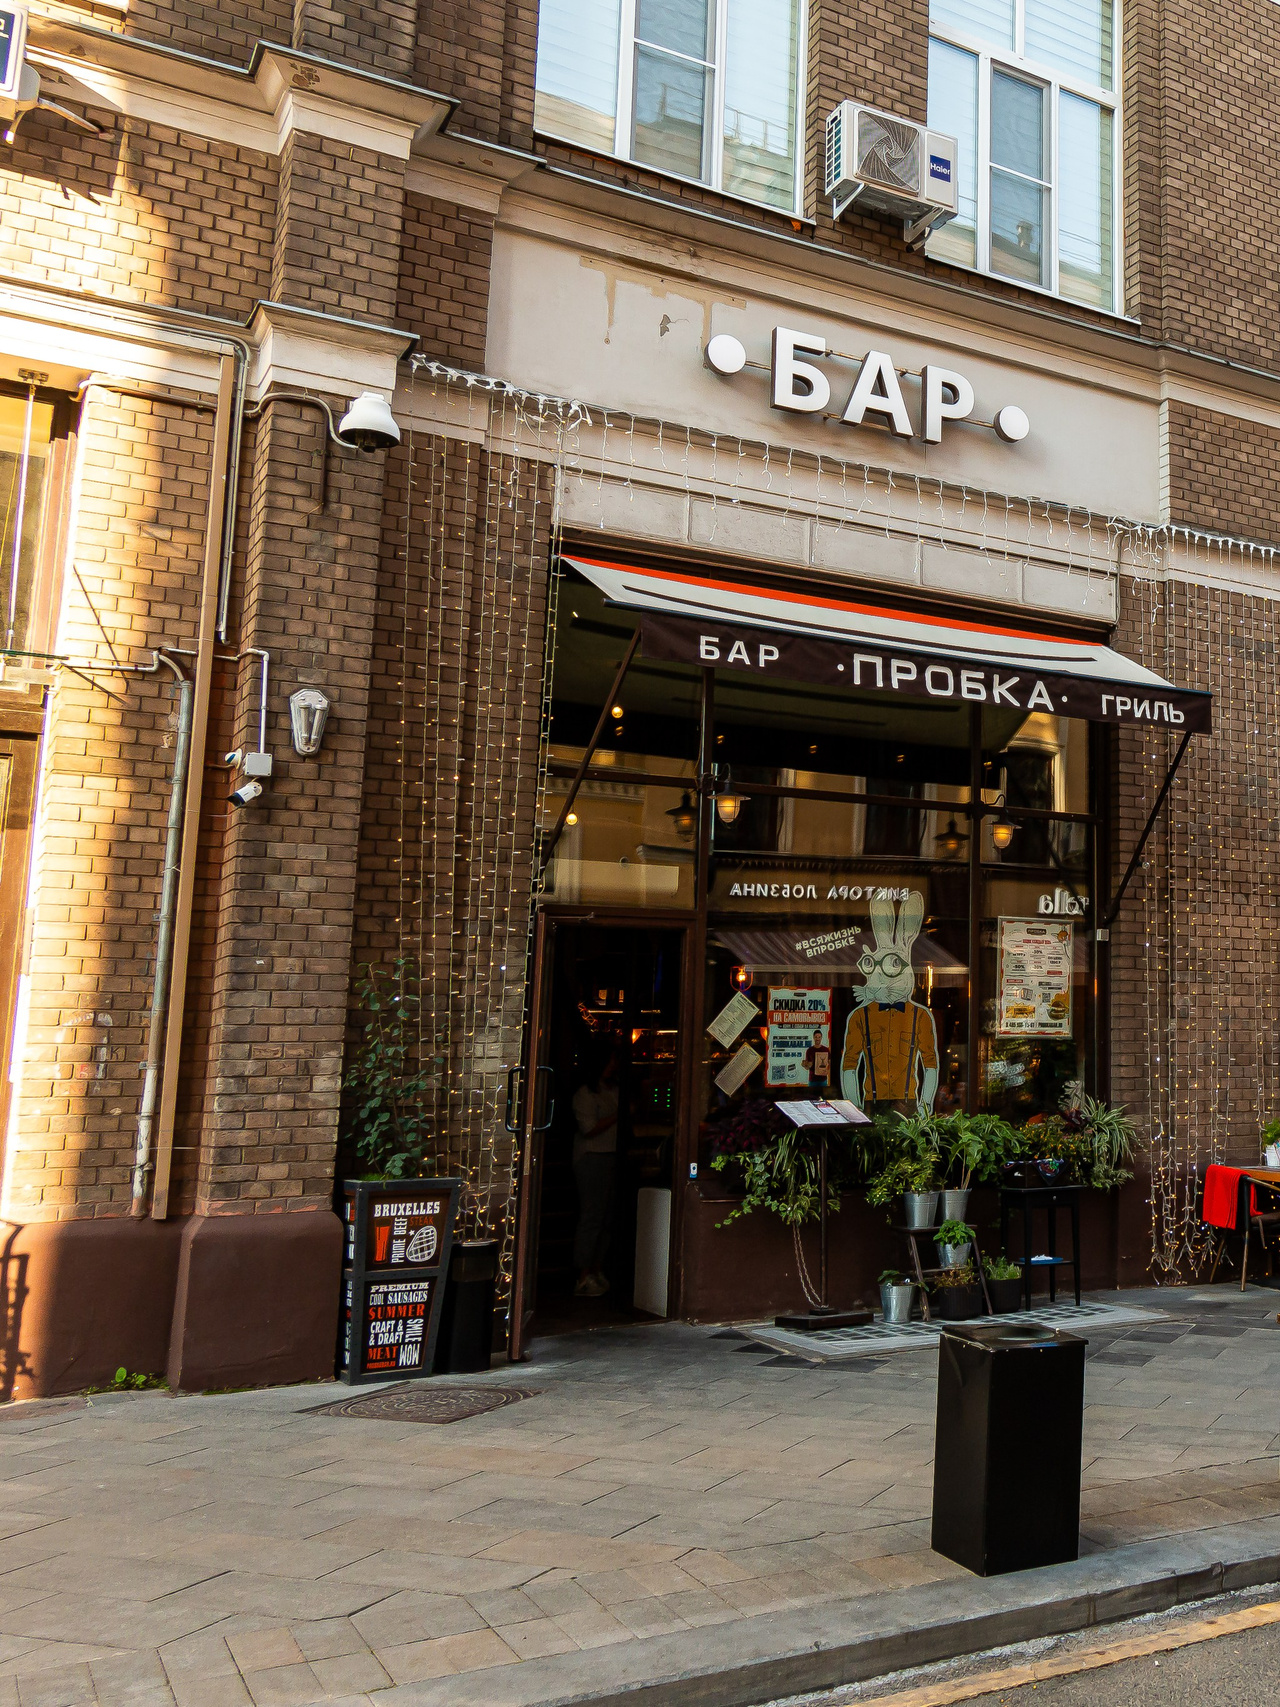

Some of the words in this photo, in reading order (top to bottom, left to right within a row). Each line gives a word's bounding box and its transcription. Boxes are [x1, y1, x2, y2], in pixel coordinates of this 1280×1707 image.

[930, 162, 951, 176] Haier
[770, 326, 976, 445] БАР
[699, 635, 780, 667] БАР
[853, 653, 1055, 712] ПРОБКА
[1101, 693, 1185, 724] ГРИЛЬ
[795, 925, 862, 951] #ВСЯЖИЗНЬ
[806, 936, 856, 958] ВПРОБКЕ
[773, 999, 806, 1012] СКИДКА
[807, 999, 826, 1011] 20%
[773, 1012, 782, 1022] НА
[783, 1012, 826, 1023] САМОВЫВОЗ
[374, 1201, 440, 1217] BRUXELLES
[394, 1217, 408, 1235] BEEF
[409, 1216, 433, 1226] STEAK
[391, 1238, 407, 1263] PRIME
[370, 1282, 429, 1293] PREMIUM
[387, 1290, 428, 1304] SAUSAGES
[368, 1304, 425, 1320] SUMMER
[370, 1320, 396, 1334] CRAFT
[377, 1331, 404, 1345] DRAFT
[367, 1346, 398, 1360] MEAT
